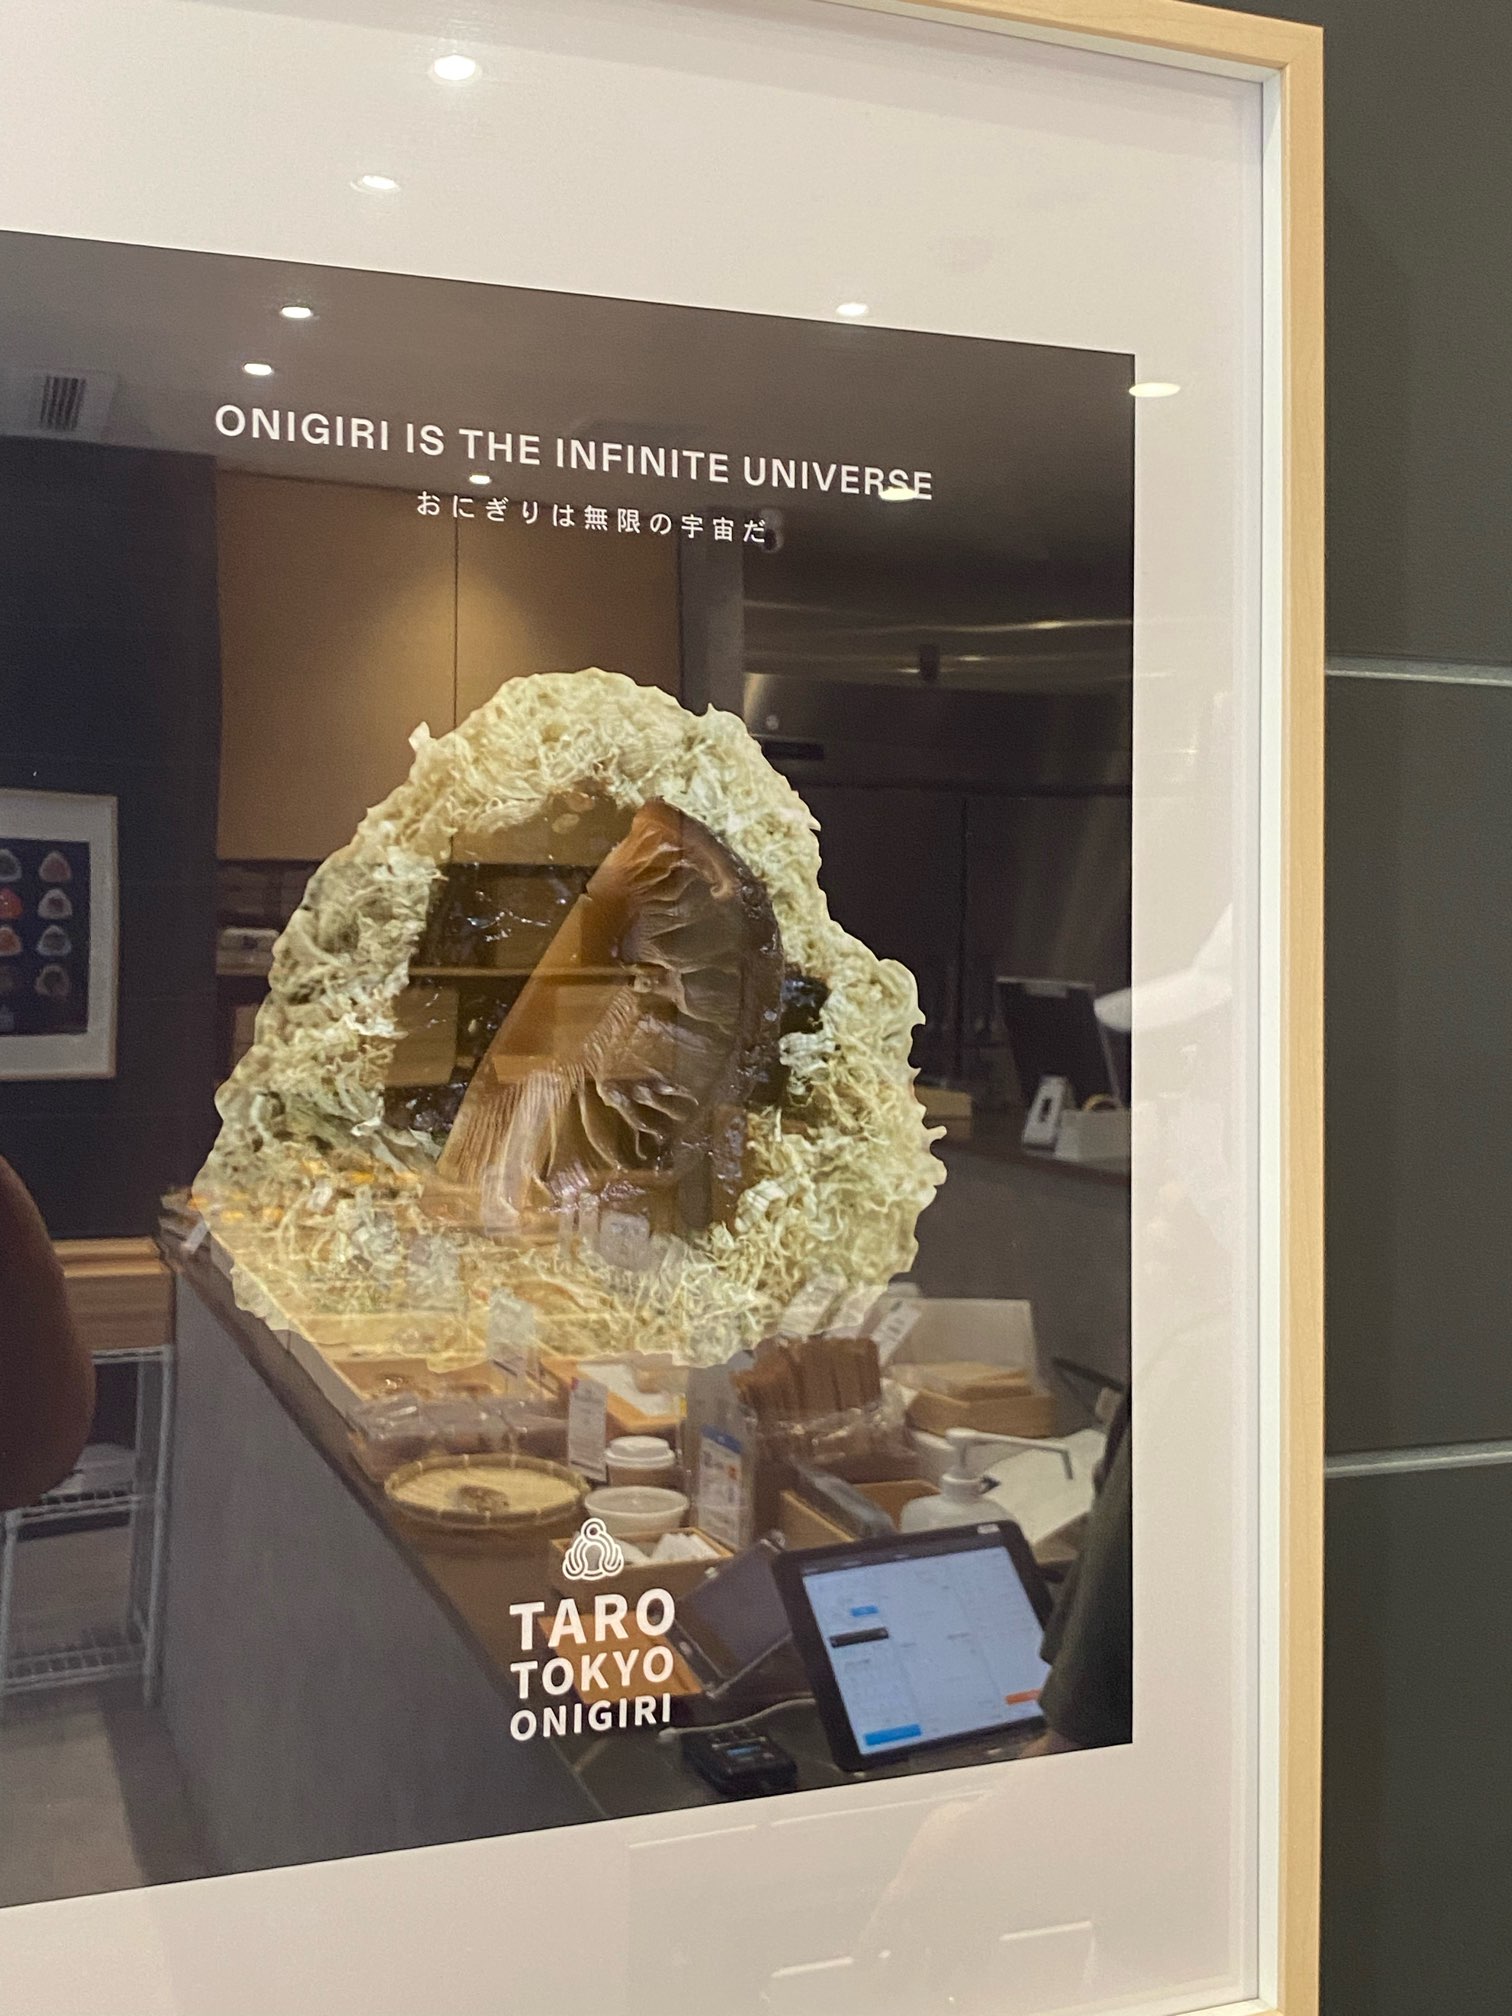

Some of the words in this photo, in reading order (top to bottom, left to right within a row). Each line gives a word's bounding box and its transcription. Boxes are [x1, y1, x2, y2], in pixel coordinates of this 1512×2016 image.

[214, 403, 390, 451] ONIGIRI
[405, 422, 445, 458] IS
[459, 428, 542, 466] THE
[555, 436, 729, 484] INFINITE
[743, 456, 933, 500] UNIVERSE
[416, 491, 767, 544] おにぎりは無限の宇宙だ
[509, 1588, 675, 1651] TARO
[510, 1645, 674, 1699] TOKYO
[509, 1693, 671, 1741] ONIGIRI
